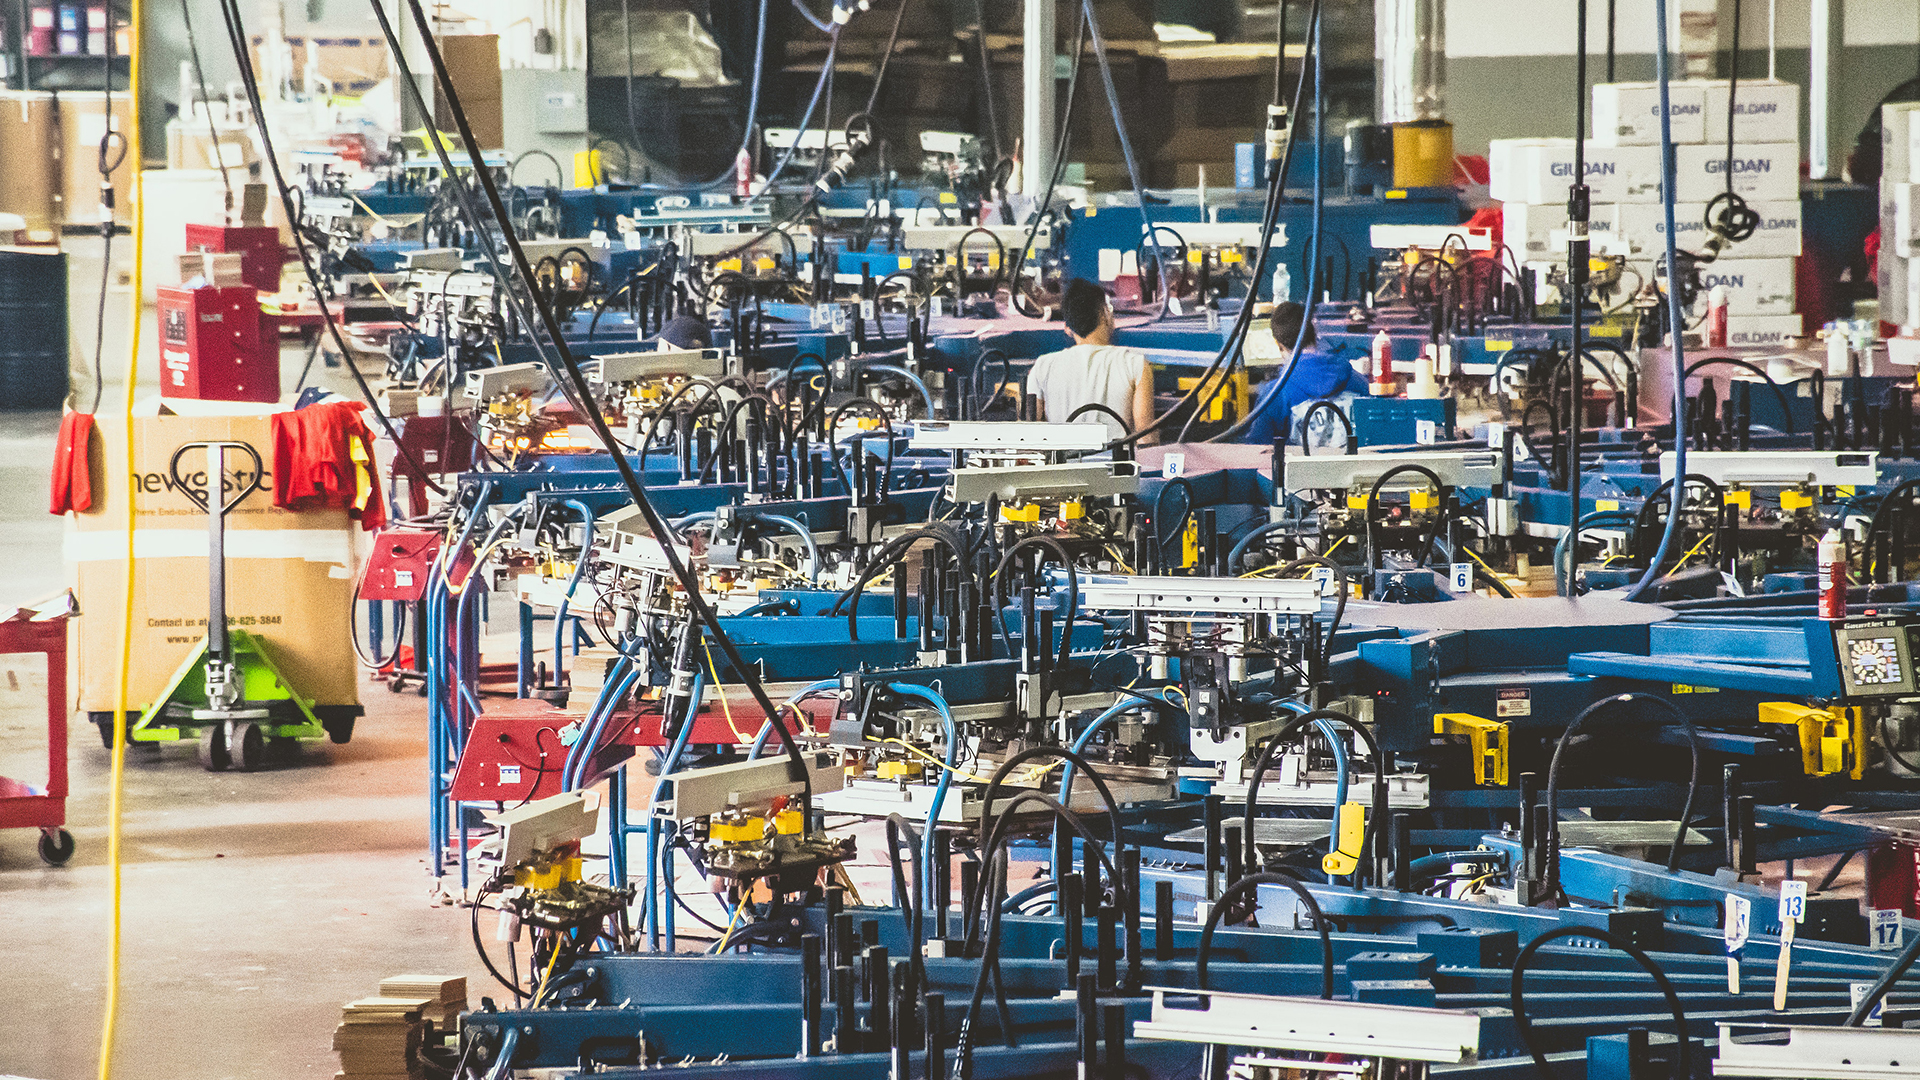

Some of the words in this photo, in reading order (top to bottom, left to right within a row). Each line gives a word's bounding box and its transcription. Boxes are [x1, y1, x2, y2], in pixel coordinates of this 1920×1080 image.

[1651, 104, 1701, 116] GDAN
[1655, 221, 1703, 233] GDAN
[1705, 273, 1744, 291] DAN
[1169, 462, 1177, 474] 8
[1319, 578, 1328, 591] 7
[1457, 573, 1467, 588] 6
[147, 618, 182, 628] Contact
[185, 619, 196, 627] us
[198, 618, 208, 627] at
[1500, 691, 1526, 699] DANGER
[1784, 896, 1802, 917] 13
[1875, 923, 1899, 944] 17
